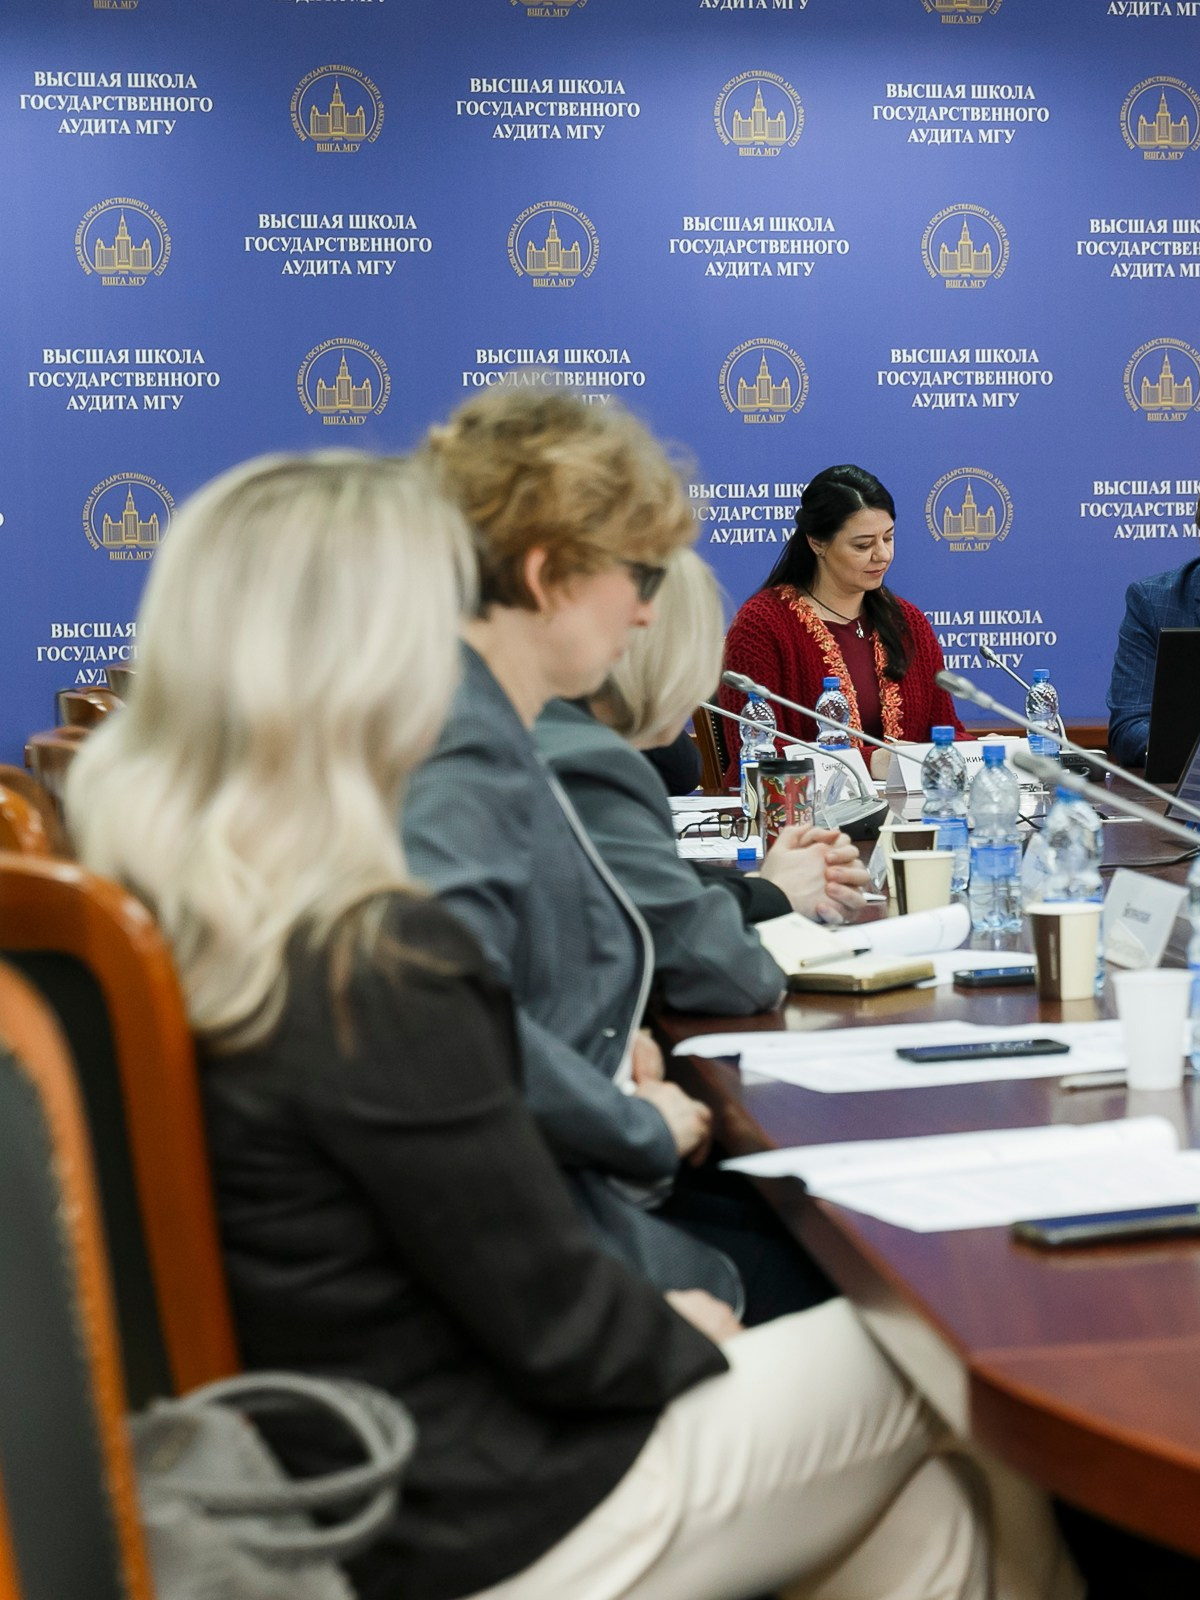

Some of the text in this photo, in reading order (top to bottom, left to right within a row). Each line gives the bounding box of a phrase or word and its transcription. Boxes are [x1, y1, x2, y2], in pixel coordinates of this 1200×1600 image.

[1106, 0, 1173, 18] АУДИТА
[34, 71, 198, 89] ВЫСШАЯ ШКОЛА
[470, 77, 626, 95] ВЫСШАЯ ШКОЛА
[886, 83, 1036, 100] ВЫСШАЯ ШКОЛА
[19, 94, 213, 113] ГОСУДАРСТВЕННОГО
[456, 100, 641, 119] ГОСУДАРСТВЕННОГО
[873, 105, 1050, 124] ГОСУДАРСТВЕННОГО
[58, 118, 177, 137] АУДИТА МГУ
[492, 123, 606, 142] АУДИТА МГУ
[907, 128, 1016, 146] АУДИТА МГУ
[317, 144, 360, 152] ВШГА МГУ
[258, 213, 418, 230] ВЫСШАЯ ШКОЛА
[683, 216, 836, 232] ВЫСШАЯ ШКОЛА
[1089, 218, 1168, 234] ВЫСШАЯ
[244, 236, 433, 255] ГОСУДАРСТВЕННОГО
[669, 238, 850, 257] ГОСУДАРСТВЕННОГО
[281, 259, 397, 278] АУДИТА МГУ
[704, 261, 816, 279] АУДИТА МГУ
[1110, 262, 1176, 280] АУДИТА
[102, 276, 146, 286] ВШГА МГУ
[534, 278, 576, 287] ВШГА МГУ
[42, 348, 206, 365] ВЫСШАЯ ШКОЛА
[476, 348, 631, 364] ВЫСШАЯ ШКОЛА
[890, 348, 1040, 364] ВЫСШАЯ ШКОЛА
[28, 371, 221, 390] ГОСУДАРСТВЕННОГО
[877, 370, 1054, 389] ГОСУДАРСТВЕННОГО
[66, 394, 184, 413] АУДИТА МГУ
[911, 392, 1020, 411] АУДИТА МГУ
[324, 416, 366, 425] ВШГА МГУ
[687, 483, 770, 499] ВЫСШАЯ
[1092, 480, 1171, 496] ВЫСШАЯ
[1080, 501, 1199, 520] ГОСУДАРСТВЕ
[709, 527, 778, 546] АУДИТА
[1113, 523, 1179, 541] АУДИТА
[110, 551, 154, 560] ВШГА МГУ
[978, 609, 1044, 625] ШКОЛА
[50, 622, 137, 639] ВЫСШАЯ
[937, 631, 1057, 648] АРСТВЕННОГО
